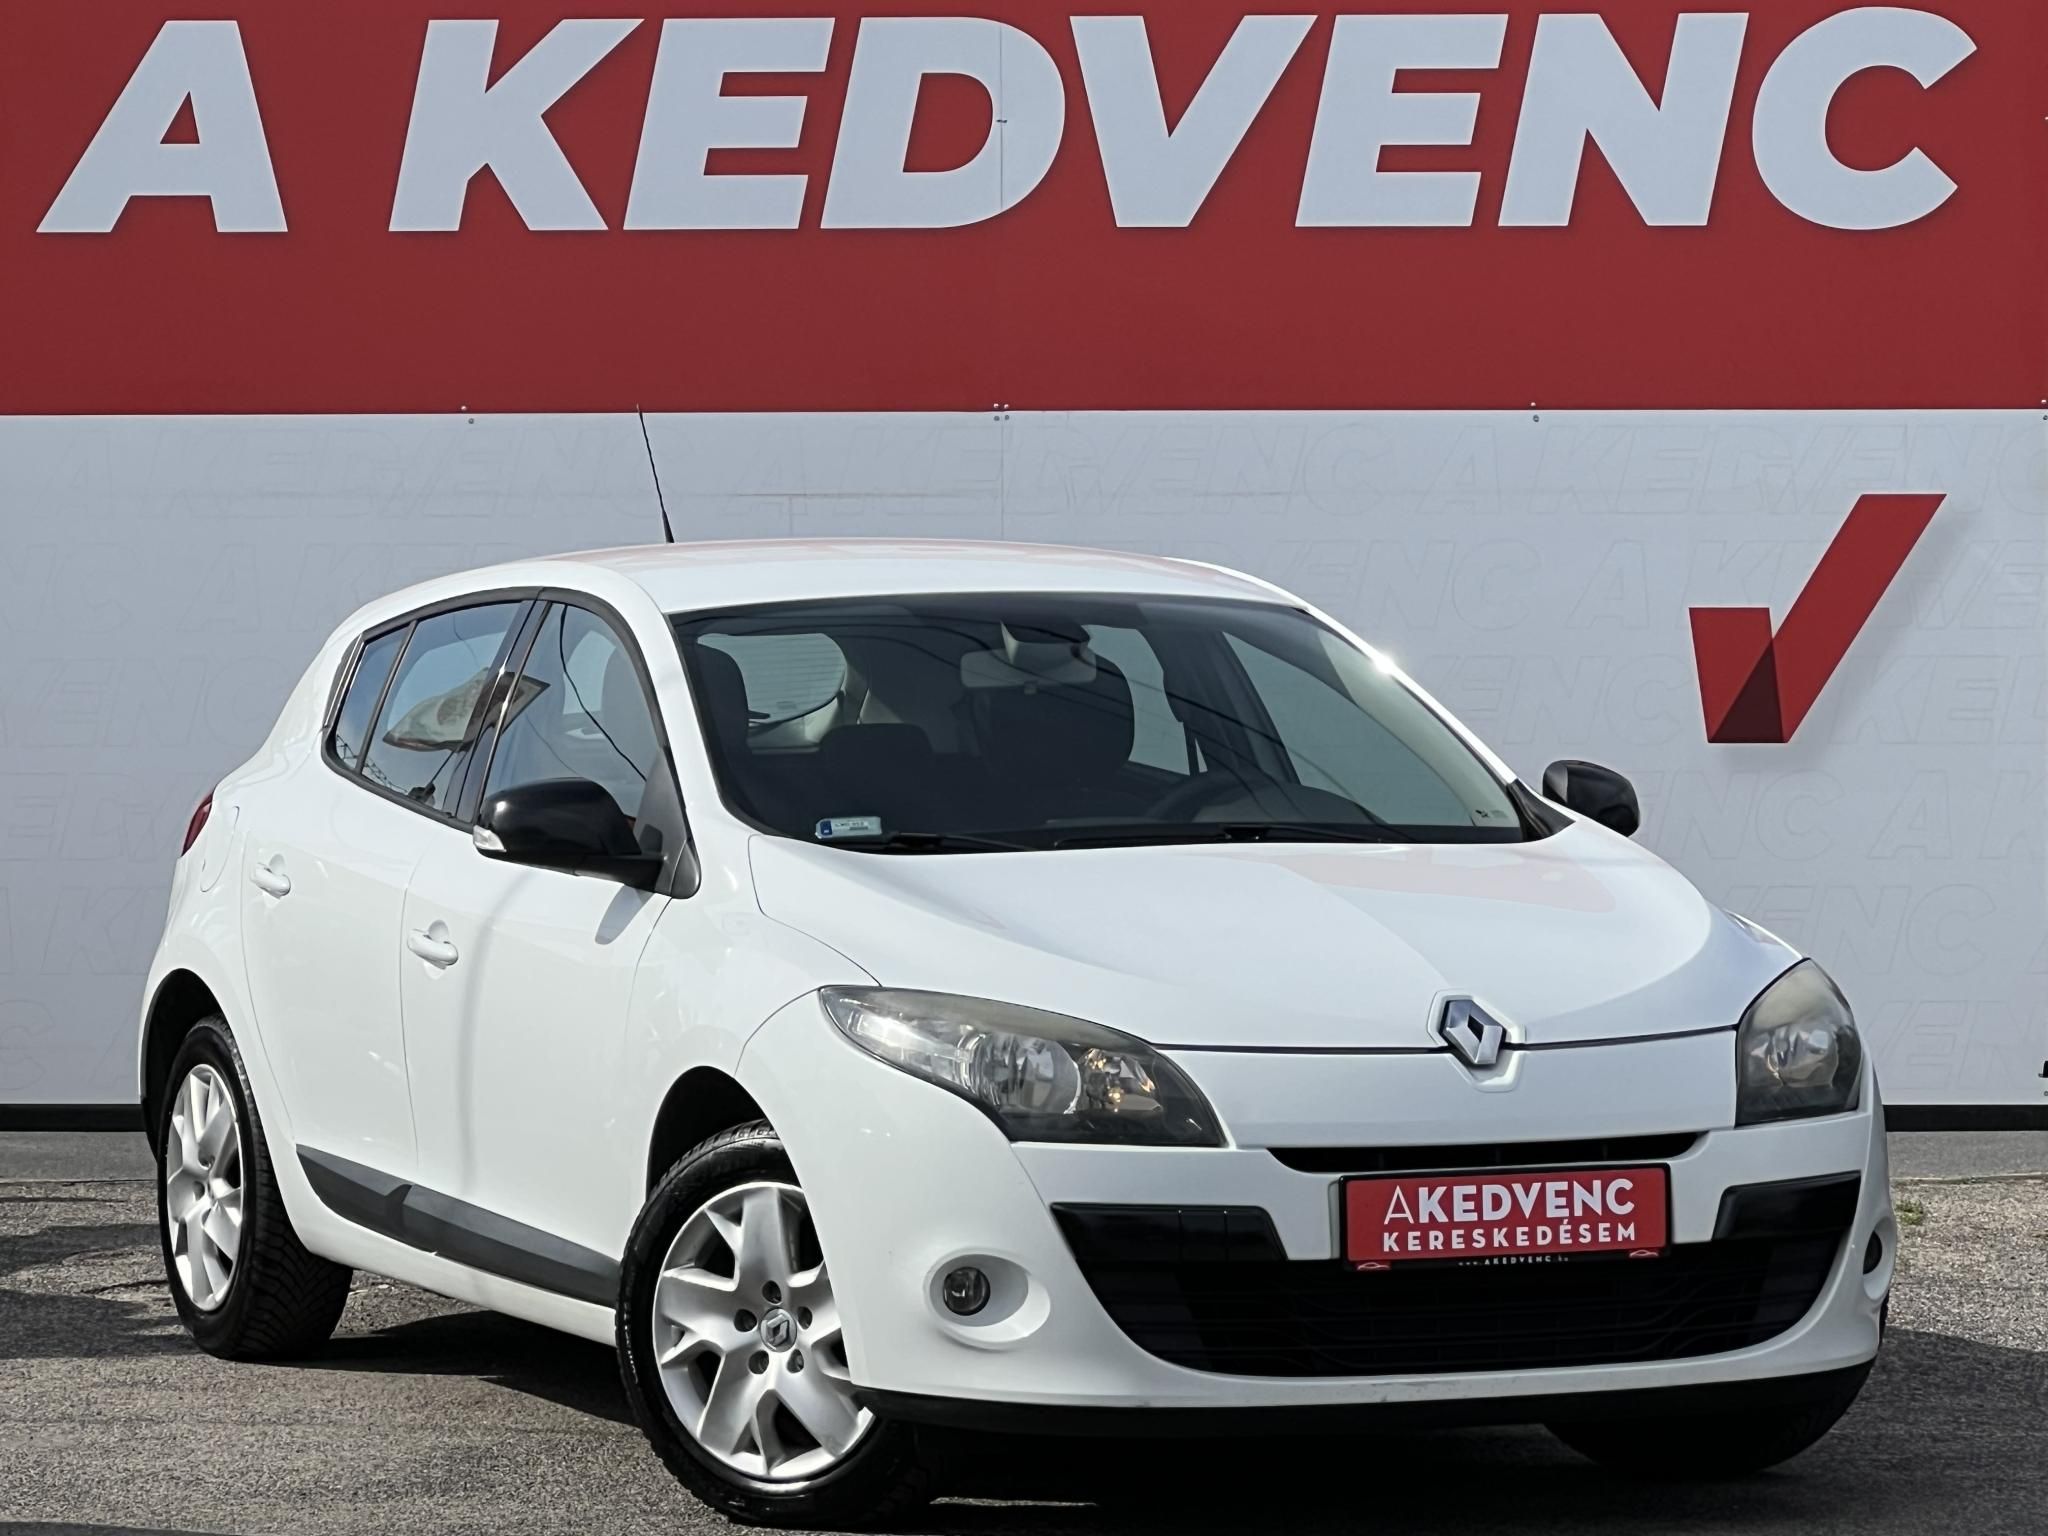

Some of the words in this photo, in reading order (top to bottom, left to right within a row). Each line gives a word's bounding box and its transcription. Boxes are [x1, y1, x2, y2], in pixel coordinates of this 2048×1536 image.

[36, 19, 289, 234] A
[387, 6, 1978, 234] KEDVENC
[1383, 1219, 1636, 1252] KERESKEDÉSEM
